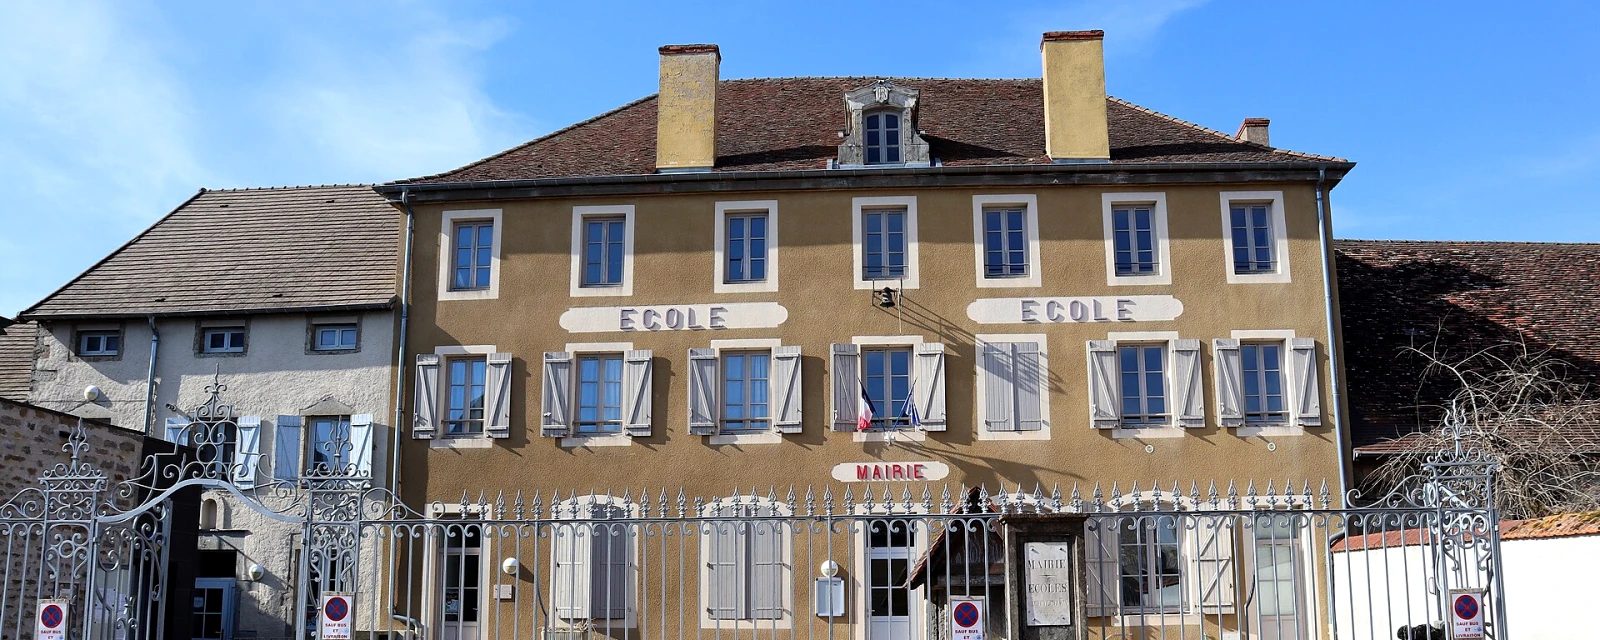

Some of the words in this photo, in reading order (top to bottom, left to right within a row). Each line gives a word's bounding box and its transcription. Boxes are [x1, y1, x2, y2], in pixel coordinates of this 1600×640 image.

[1020, 298, 1136, 323] ECOLE
[620, 307, 728, 331] ECOLE
[857, 464, 926, 480] MAIRIE
[1028, 560, 1066, 569] MAIRIE
[1028, 583, 1067, 593] ECOLES
